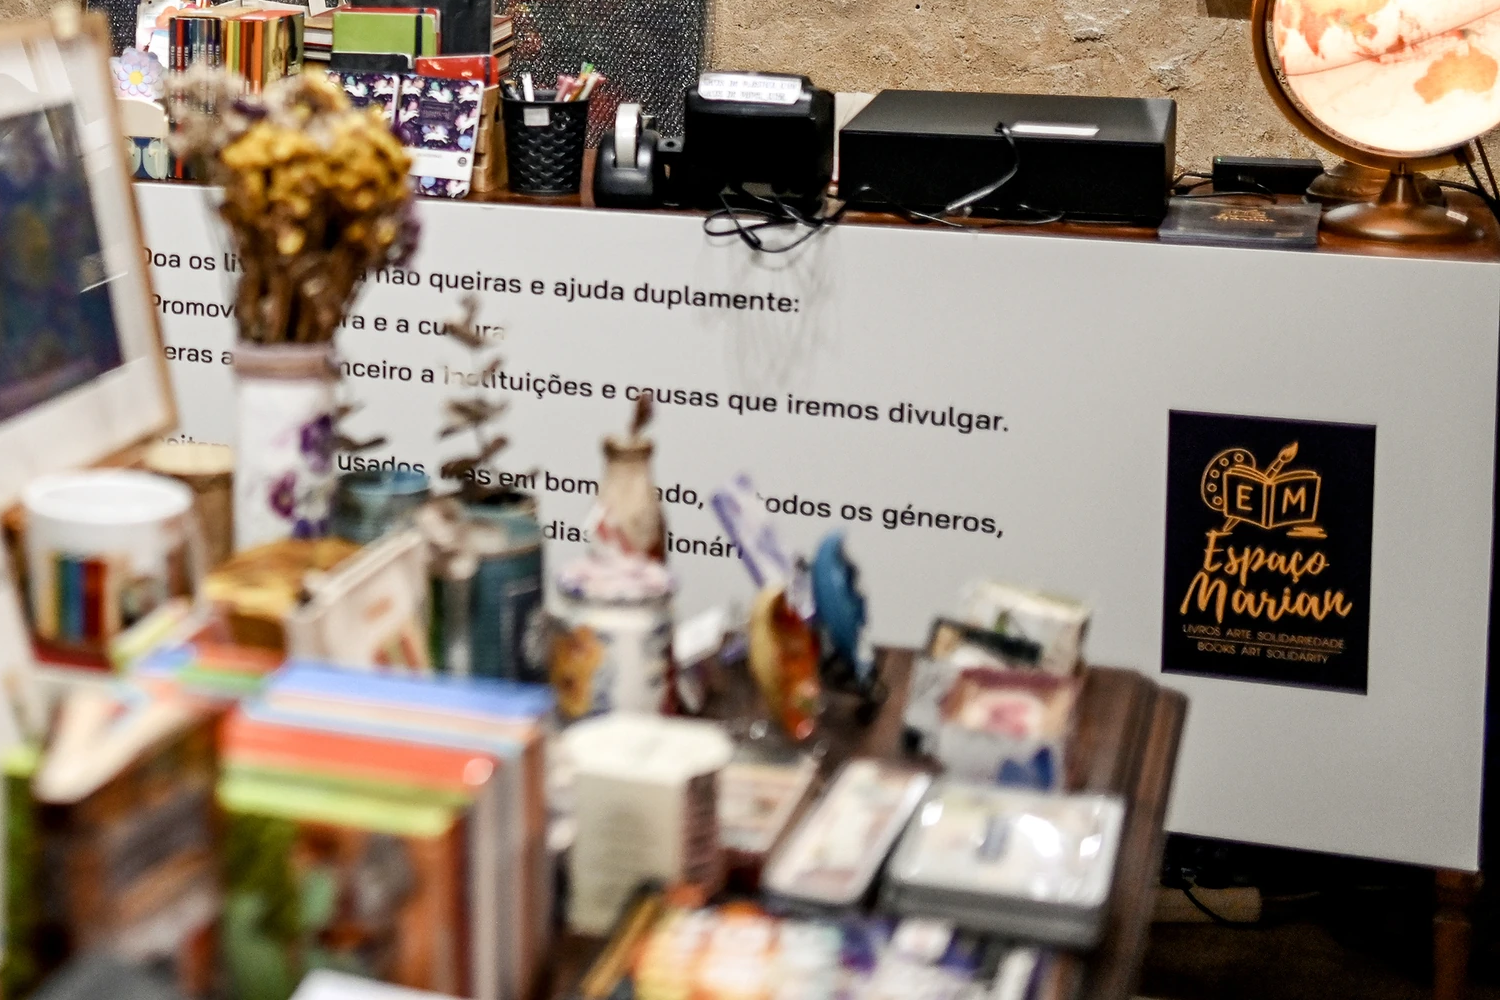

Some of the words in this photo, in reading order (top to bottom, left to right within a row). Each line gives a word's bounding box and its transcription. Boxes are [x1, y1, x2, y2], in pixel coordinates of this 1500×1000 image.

[189, 255, 216, 272] os
[429, 272, 521, 293] queiras
[530, 279, 545, 296] e
[553, 277, 624, 303] ajuda
[634, 281, 800, 314] duplamente:
[373, 316, 387, 332] e
[396, 317, 409, 333] a
[164, 345, 213, 365] eras
[420, 367, 434, 384] a
[601, 381, 616, 399] e
[625, 381, 719, 409] causas
[728, 390, 778, 417] que
[786, 393, 879, 423] iremos
[888, 402, 1010, 436] divulgar.
[499, 473, 537, 490] em
[545, 470, 599, 496] bom
[841, 502, 873, 522] os
[881, 504, 1005, 539] géneros,
[1236, 485, 1254, 510] E
[1282, 486, 1306, 514] M
[1204, 529, 1330, 587] Espaço
[1180, 571, 1353, 624] Marian
[1182, 624, 1222, 637] LIVROS
[1226, 627, 1252, 639] ARTE
[1257, 630, 1344, 649] SOLIDARIEDADE
[1197, 641, 1236, 655] BOOKS
[1240, 645, 1261, 657] ART
[1266, 648, 1330, 664] SOLIDARITY
